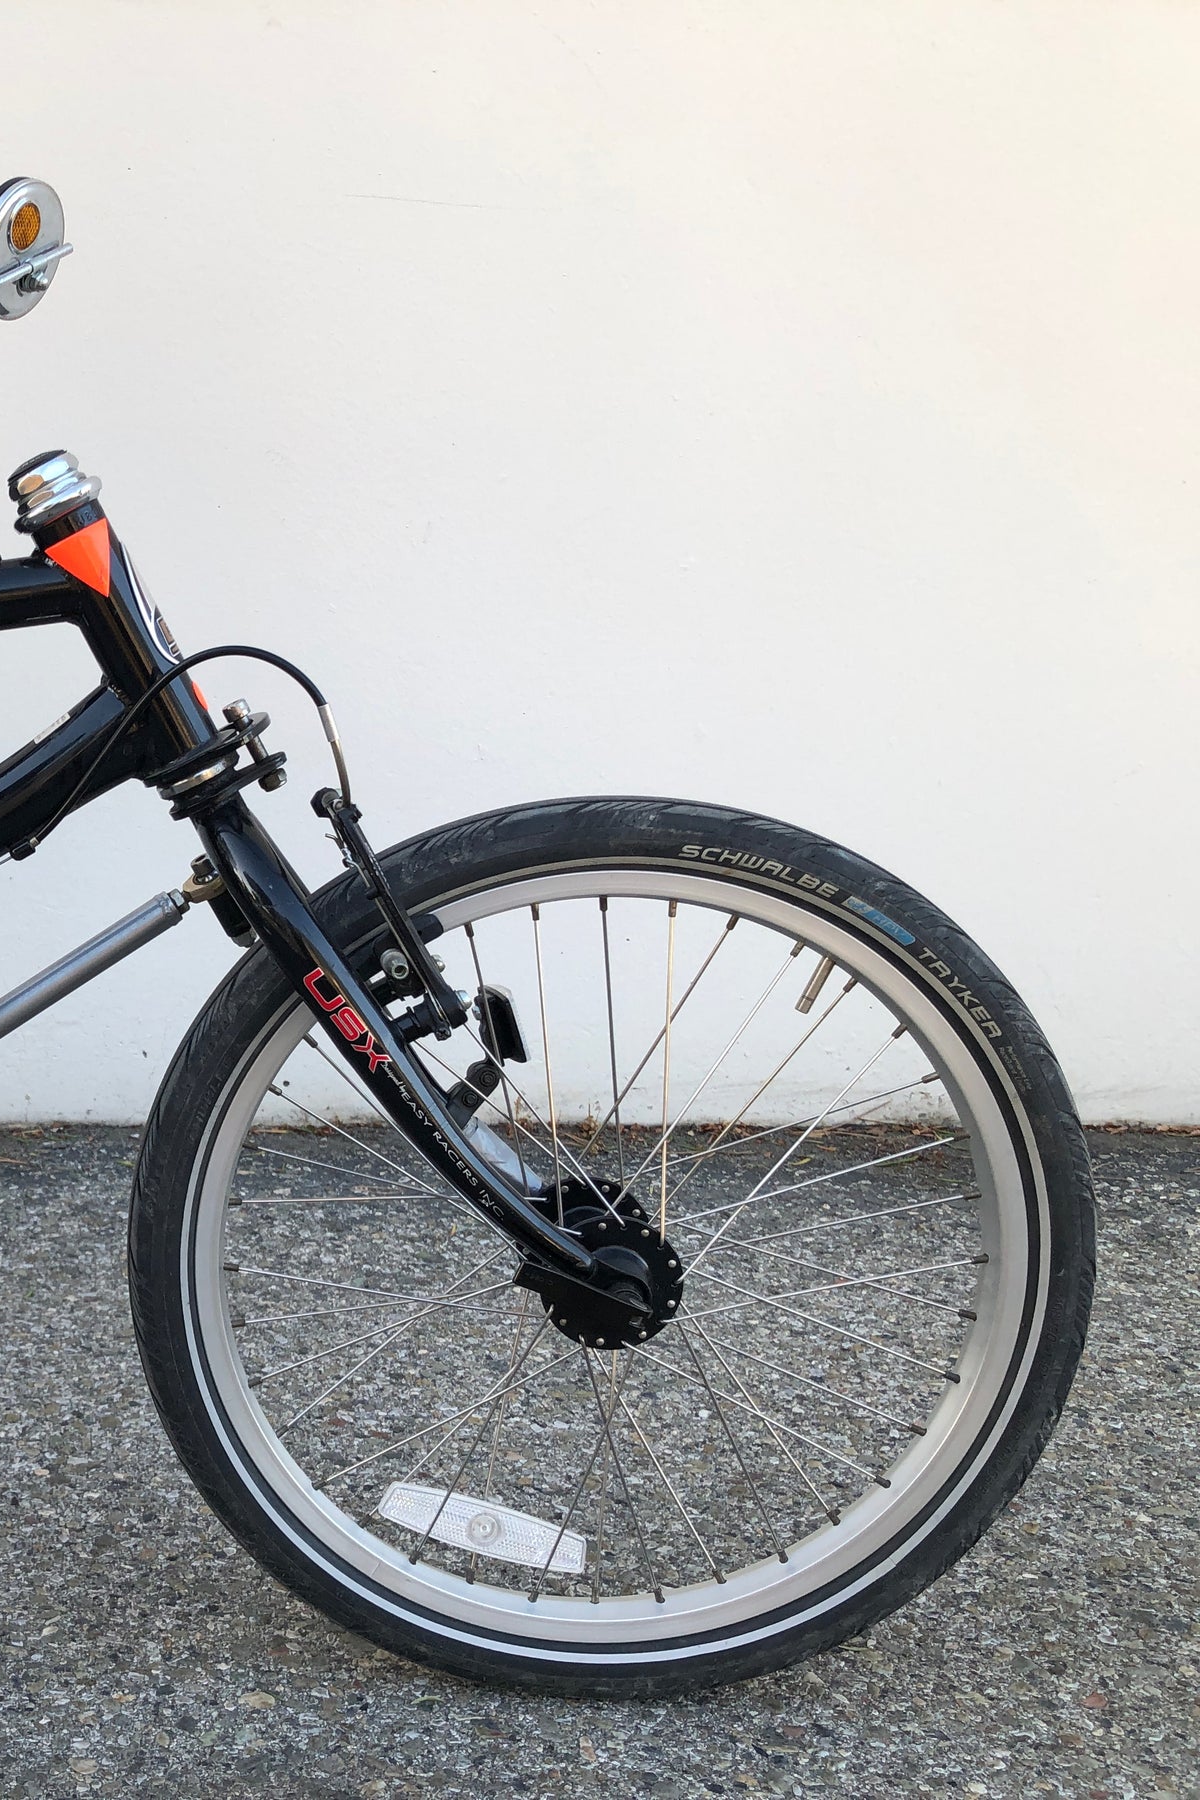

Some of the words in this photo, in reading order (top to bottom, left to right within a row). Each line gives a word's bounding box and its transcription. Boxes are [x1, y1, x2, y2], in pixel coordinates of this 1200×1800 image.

[679, 845, 840, 899] SCHWALBE
[303, 967, 392, 1074] USX
[918, 947, 1003, 1039] TRYKER
[402, 1090, 433, 1127] EASY
[433, 1131, 479, 1187] RACERS
[478, 1189, 505, 1222] INC.
